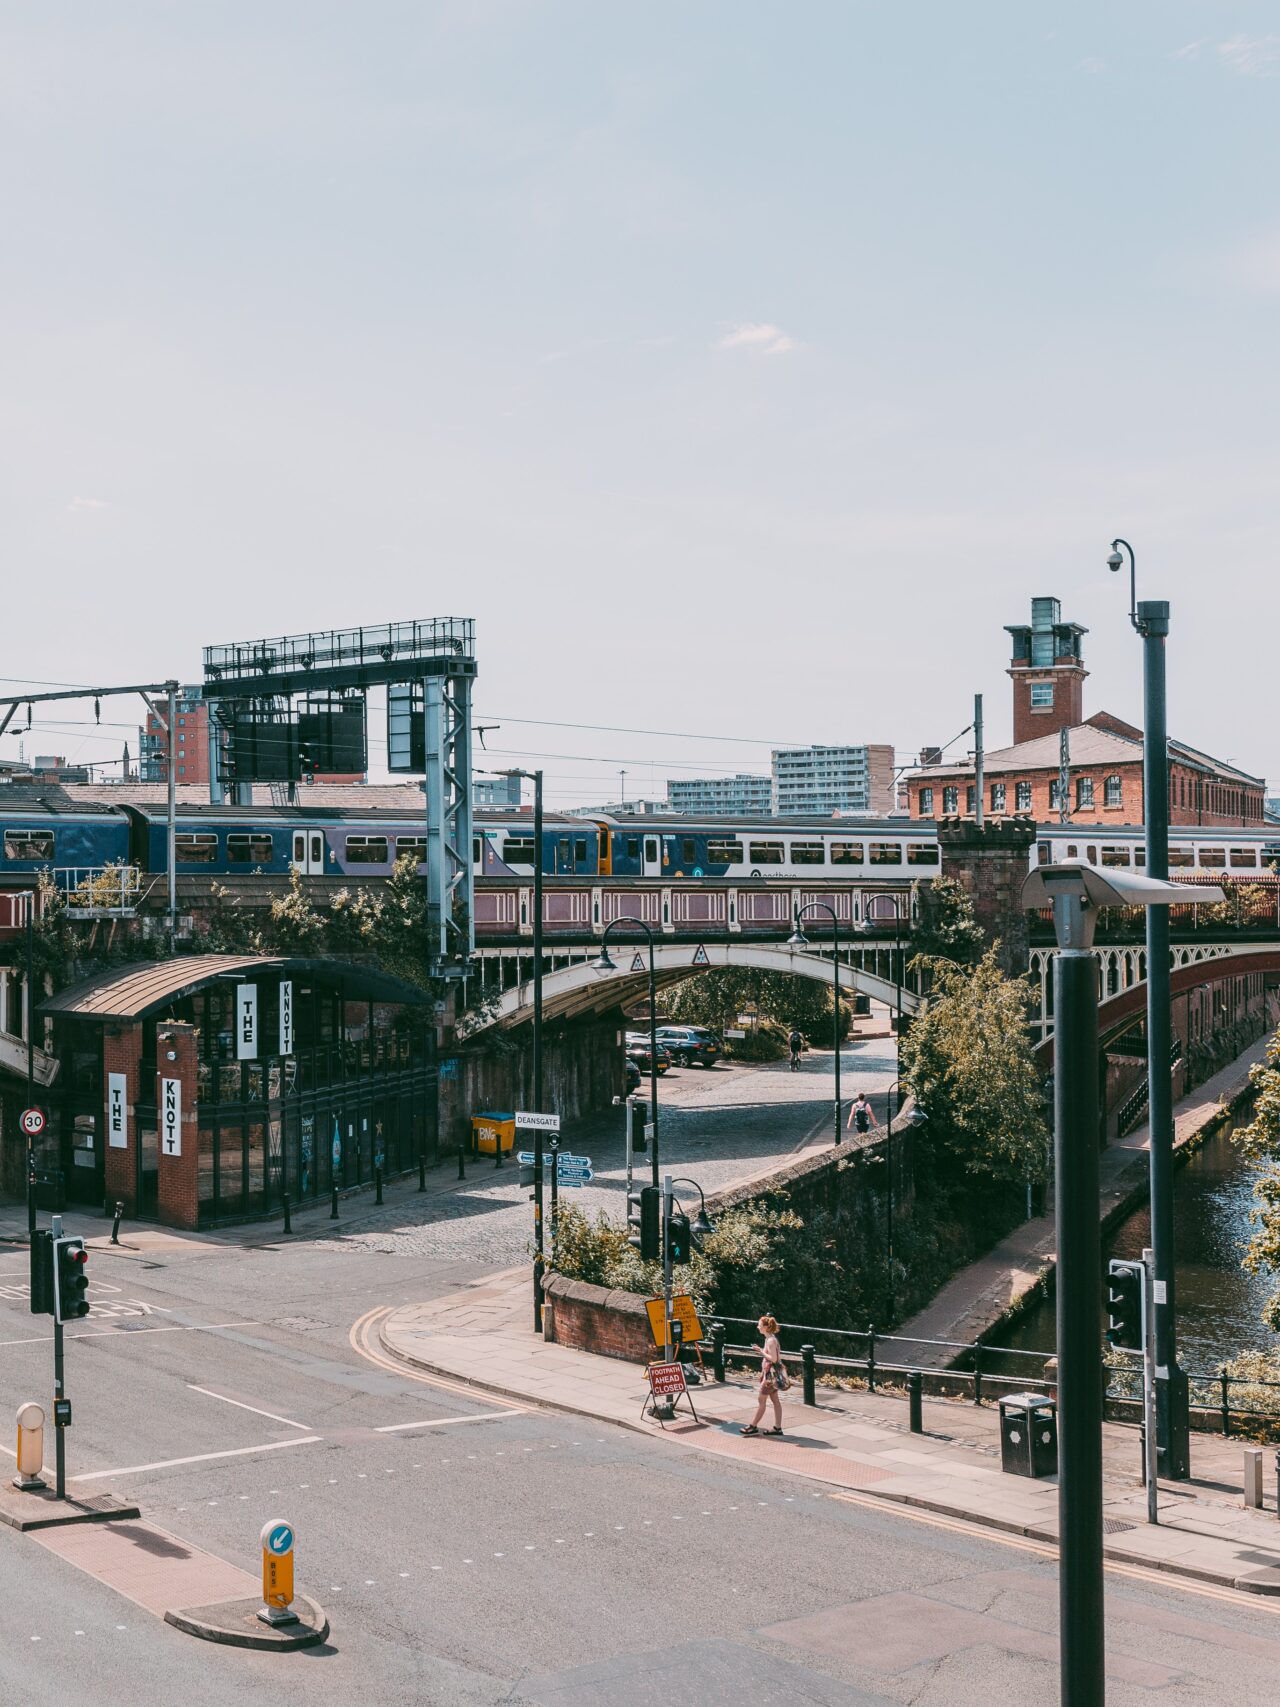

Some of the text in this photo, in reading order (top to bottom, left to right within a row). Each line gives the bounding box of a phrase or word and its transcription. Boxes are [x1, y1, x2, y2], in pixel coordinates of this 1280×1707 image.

[243, 1001, 253, 1043] THE
[112, 1089, 122, 1132] THE
[26, 1116, 42, 1127] 30
[166, 1081, 176, 1153] KNOTT
[517, 1116, 558, 1127] DEANSGATE
[651, 1366, 681, 1376] FOOTPATH
[655, 1374, 680, 1384] AHEAD
[654, 1383, 684, 1394] CLOSED
